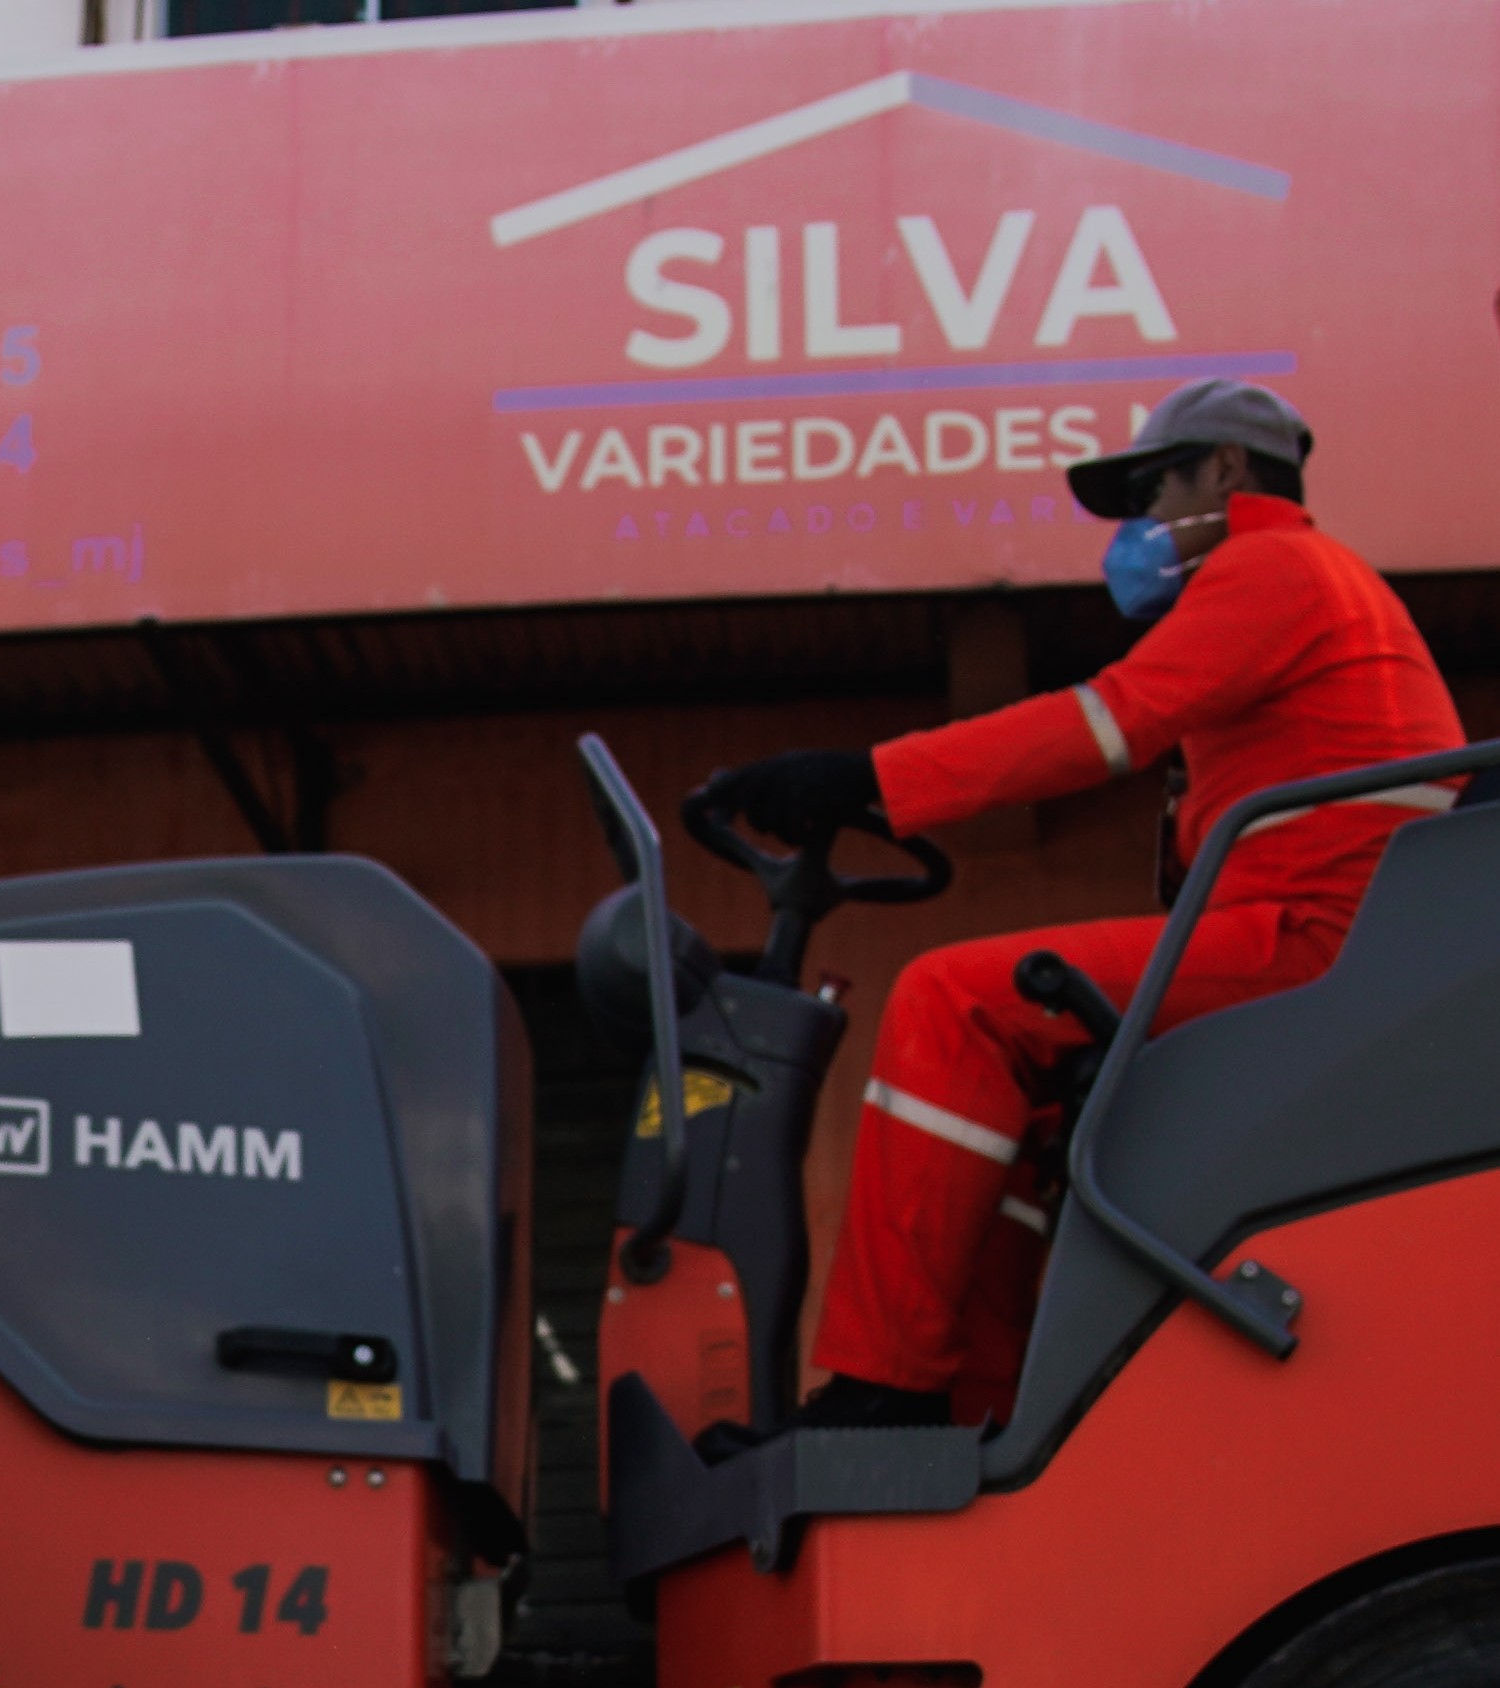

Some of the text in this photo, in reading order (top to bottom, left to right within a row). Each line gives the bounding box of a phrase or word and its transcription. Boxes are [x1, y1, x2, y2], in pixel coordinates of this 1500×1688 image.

[624, 205, 1178, 368] SILVA
[521, 406, 1101, 492] VARIEDADES
[614, 502, 877, 541] ATACADO
[903, 500, 925, 531] E
[75, 1115, 303, 1181] HAMM
[79, 1557, 331, 1637] HD 14
